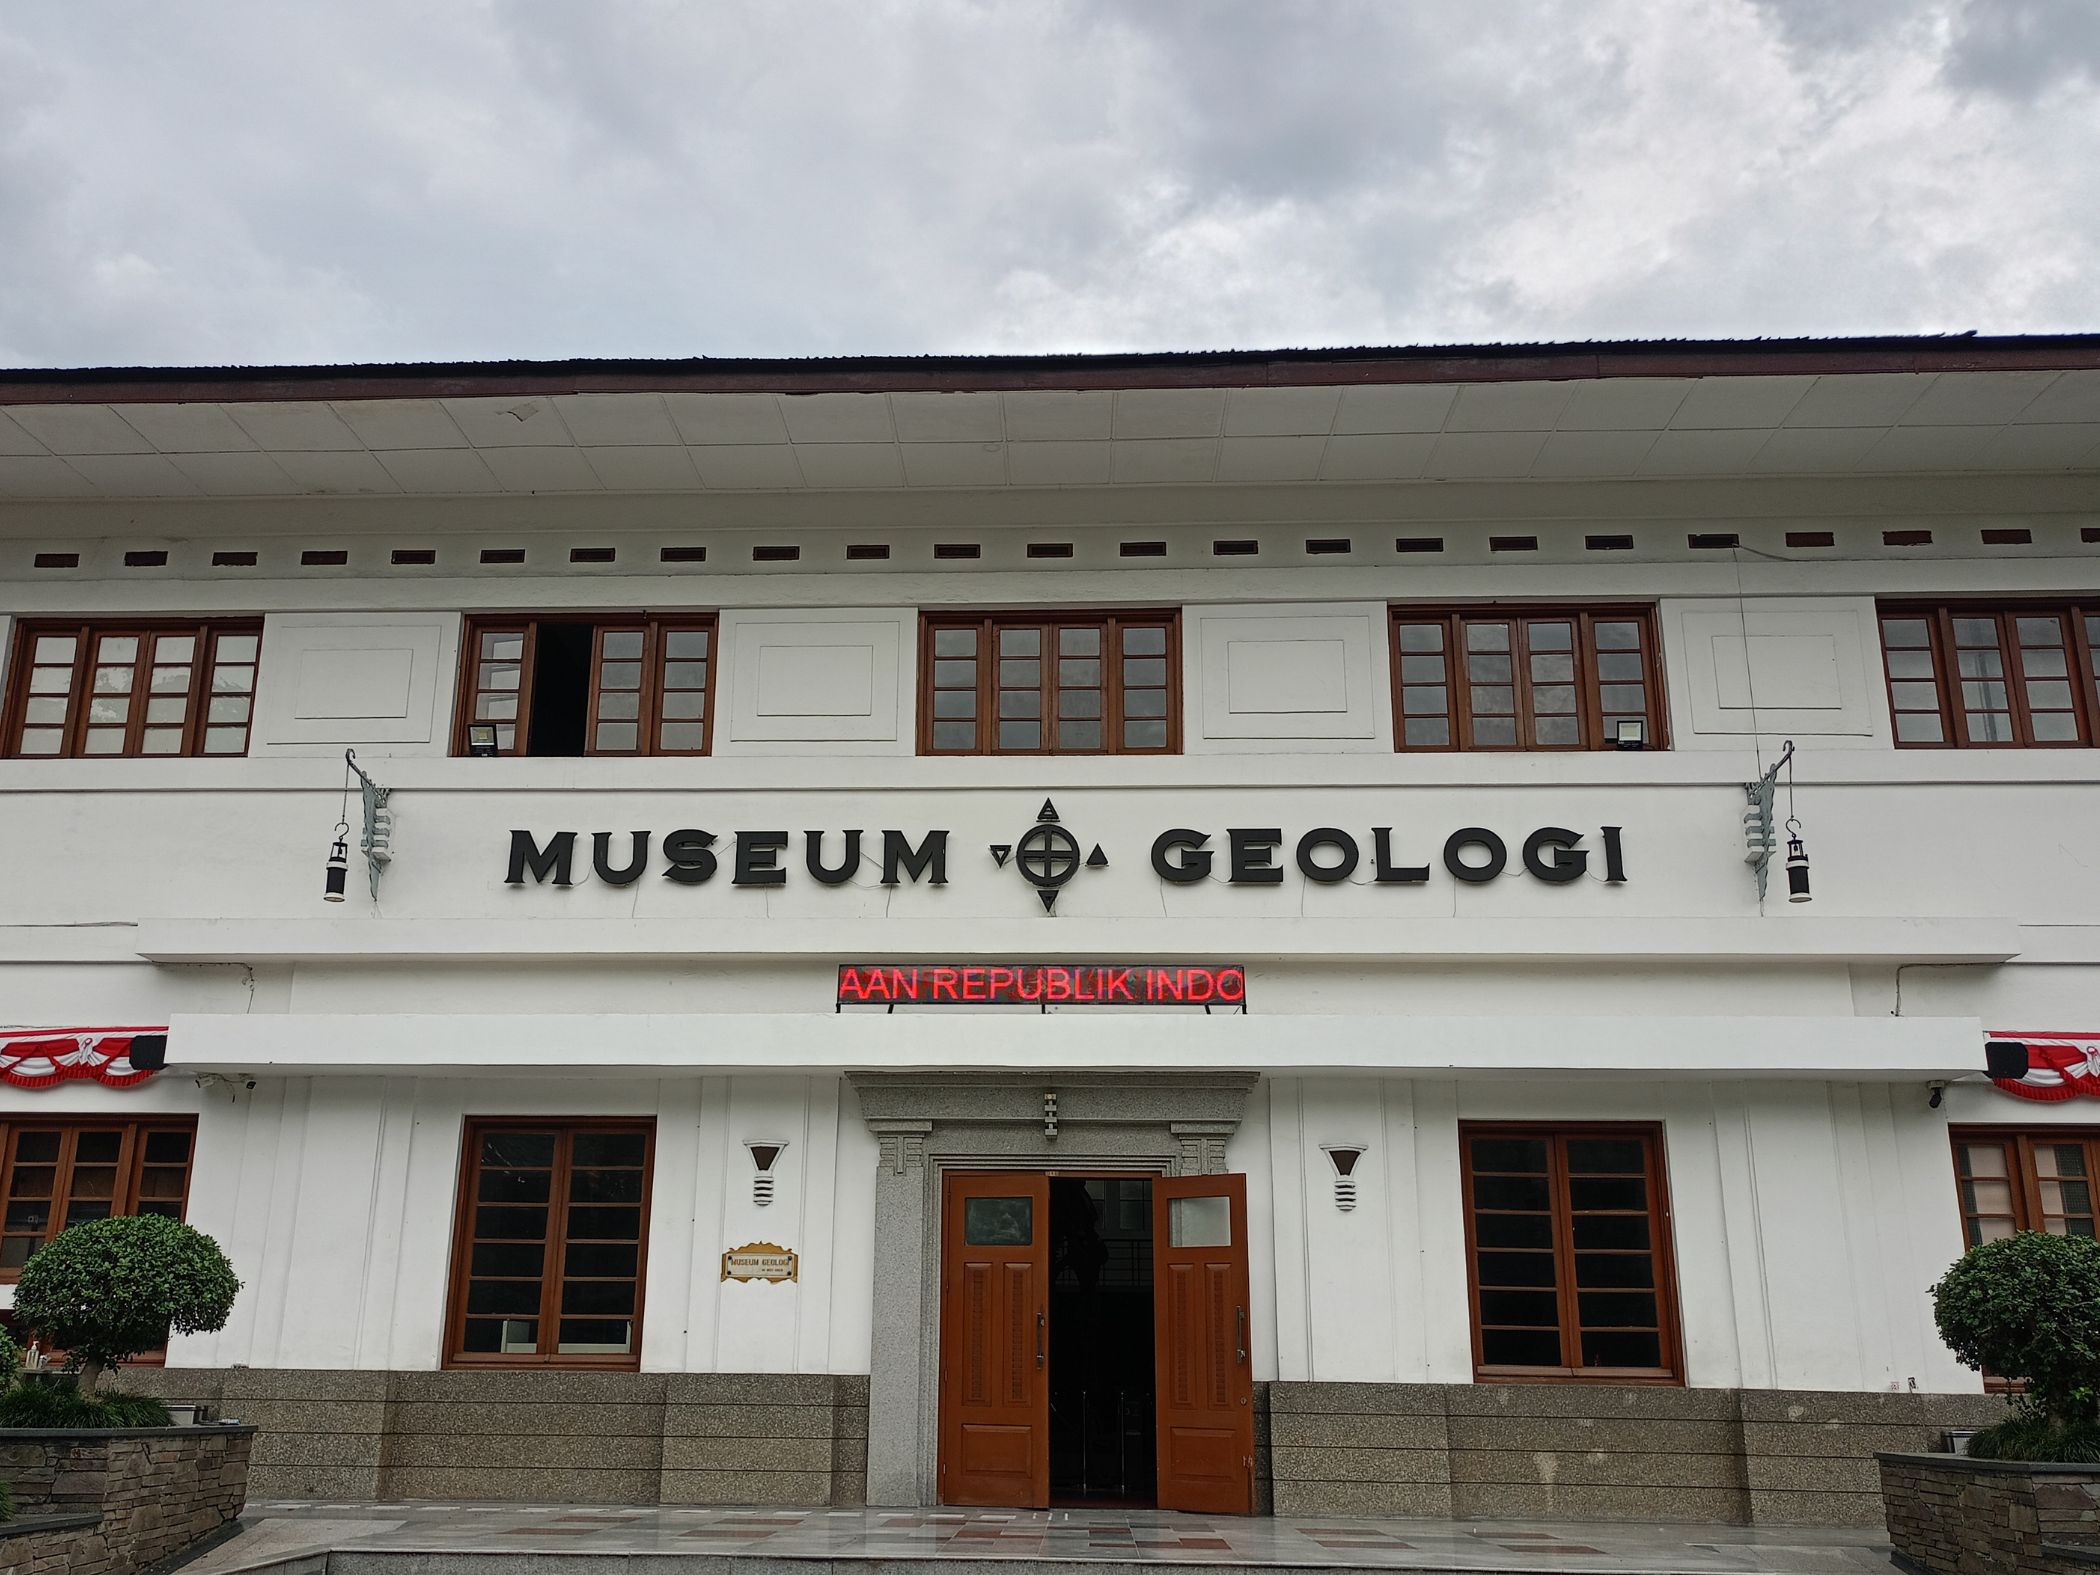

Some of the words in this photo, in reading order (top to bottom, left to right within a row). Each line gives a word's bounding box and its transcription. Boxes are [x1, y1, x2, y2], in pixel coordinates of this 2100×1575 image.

[504, 829, 950, 889] MUSEUM
[1151, 827, 1628, 887] GEOLOGI
[839, 968, 918, 999] AAN
[931, 968, 1134, 999] REPUBLIK
[731, 1258, 759, 1266] MUSEUM
[761, 1258, 790, 1266] GEOLOGI
